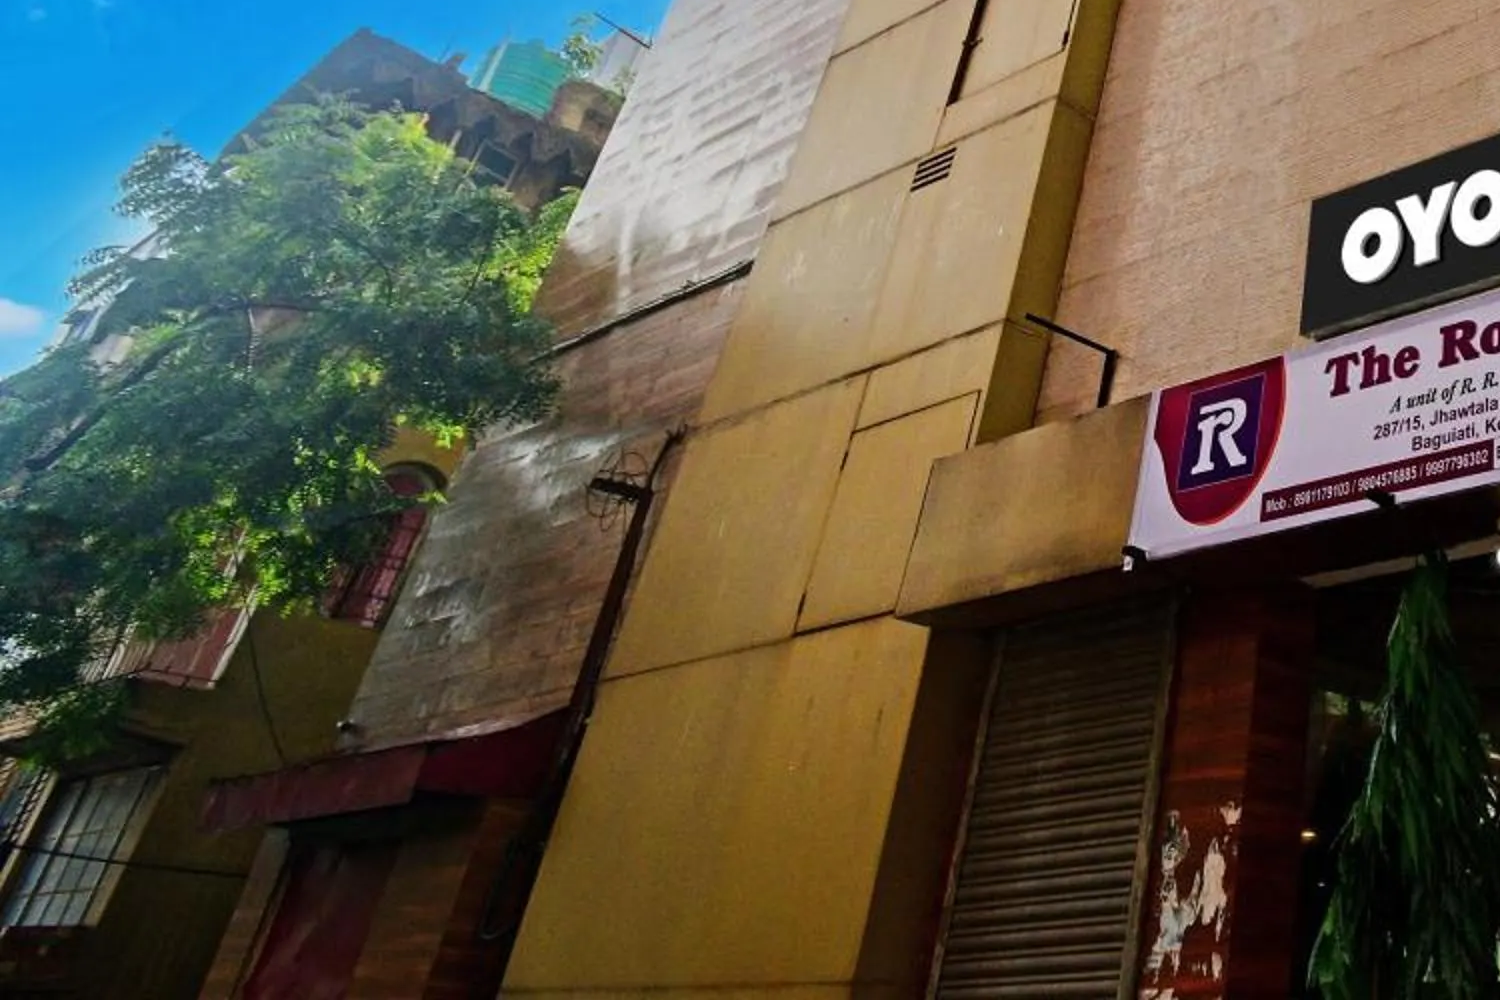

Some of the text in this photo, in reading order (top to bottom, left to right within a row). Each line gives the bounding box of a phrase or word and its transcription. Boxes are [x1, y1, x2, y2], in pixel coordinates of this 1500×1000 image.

[1324, 345, 1420, 399] The
[1389, 396, 1401, 414] A
[1406, 388, 1437, 410] unit
[1441, 380, 1459, 405] of
[1460, 377, 1477, 398] R.
[1482, 371, 1499, 390] R.
[1190, 397, 1247, 475] R
[1373, 415, 1425, 441] 287/15,
[1429, 397, 1499, 427] Jhawtala
